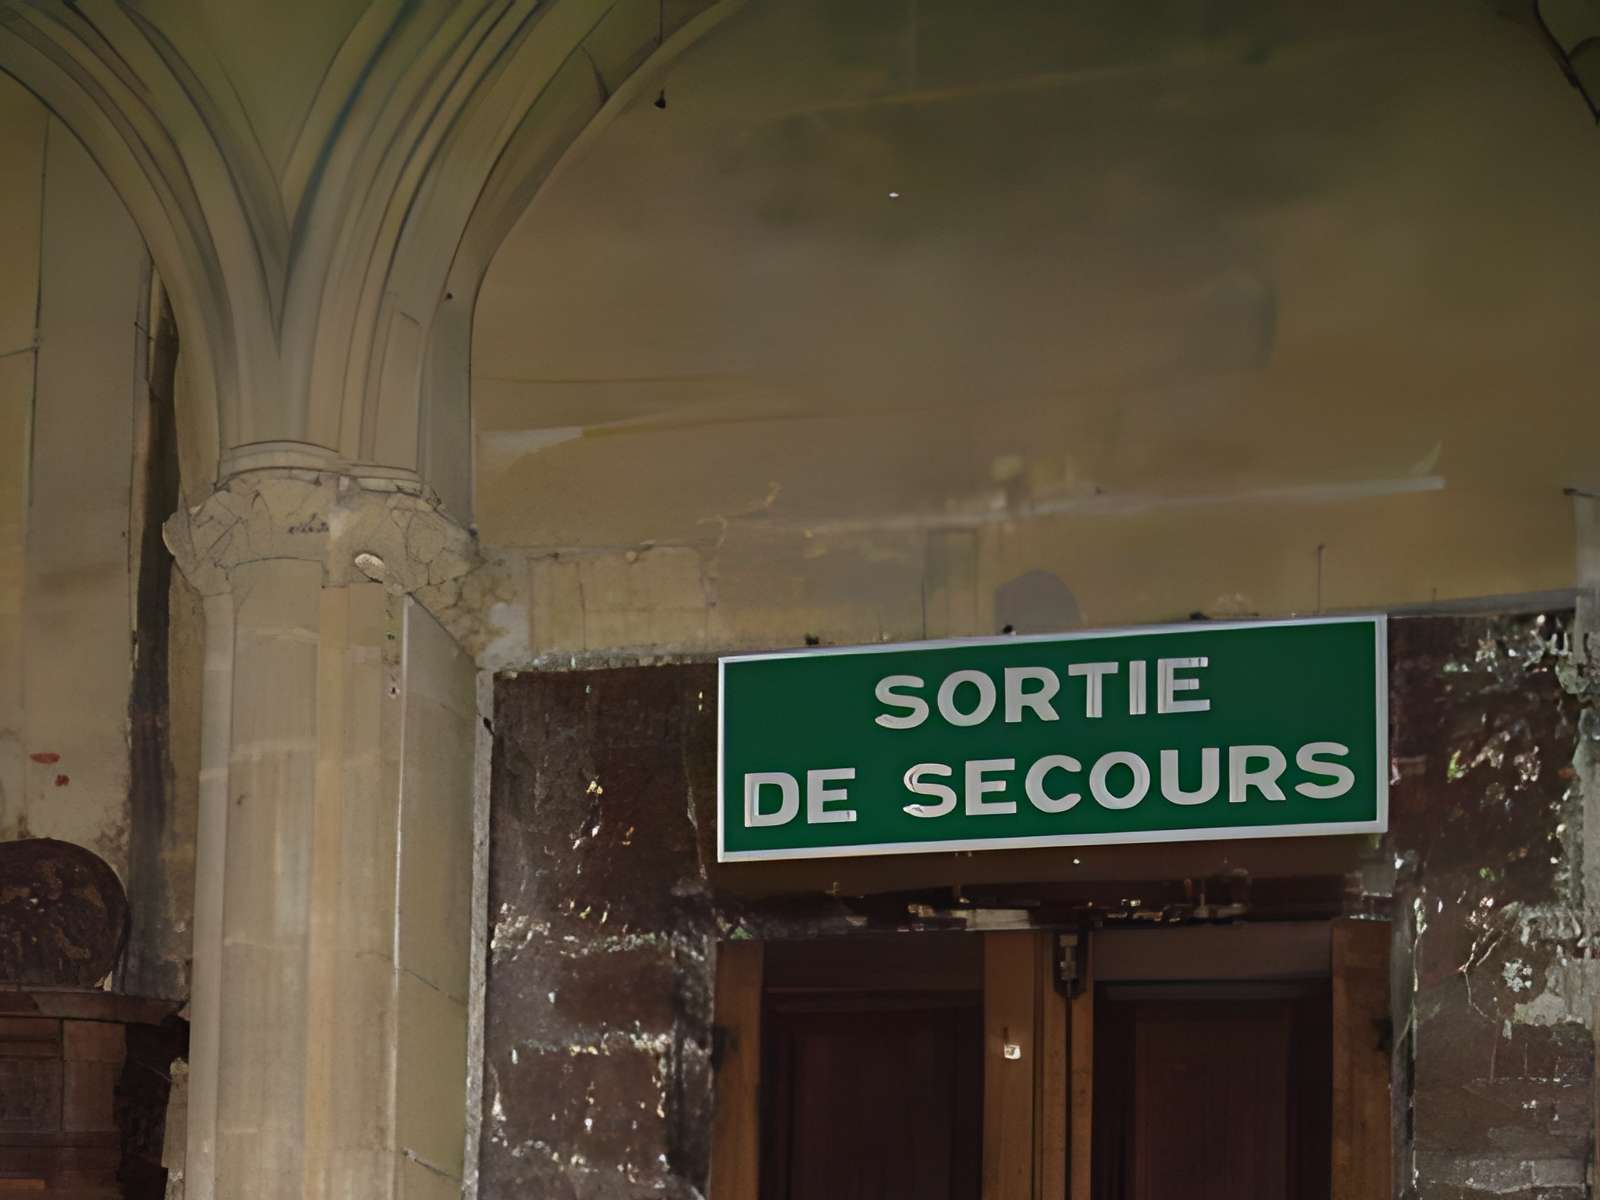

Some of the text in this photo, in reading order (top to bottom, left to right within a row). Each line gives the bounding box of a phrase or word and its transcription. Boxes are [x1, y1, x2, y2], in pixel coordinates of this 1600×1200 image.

[875, 657, 1210, 729] SORTIE
[744, 741, 1355, 828] DE SECOURS
